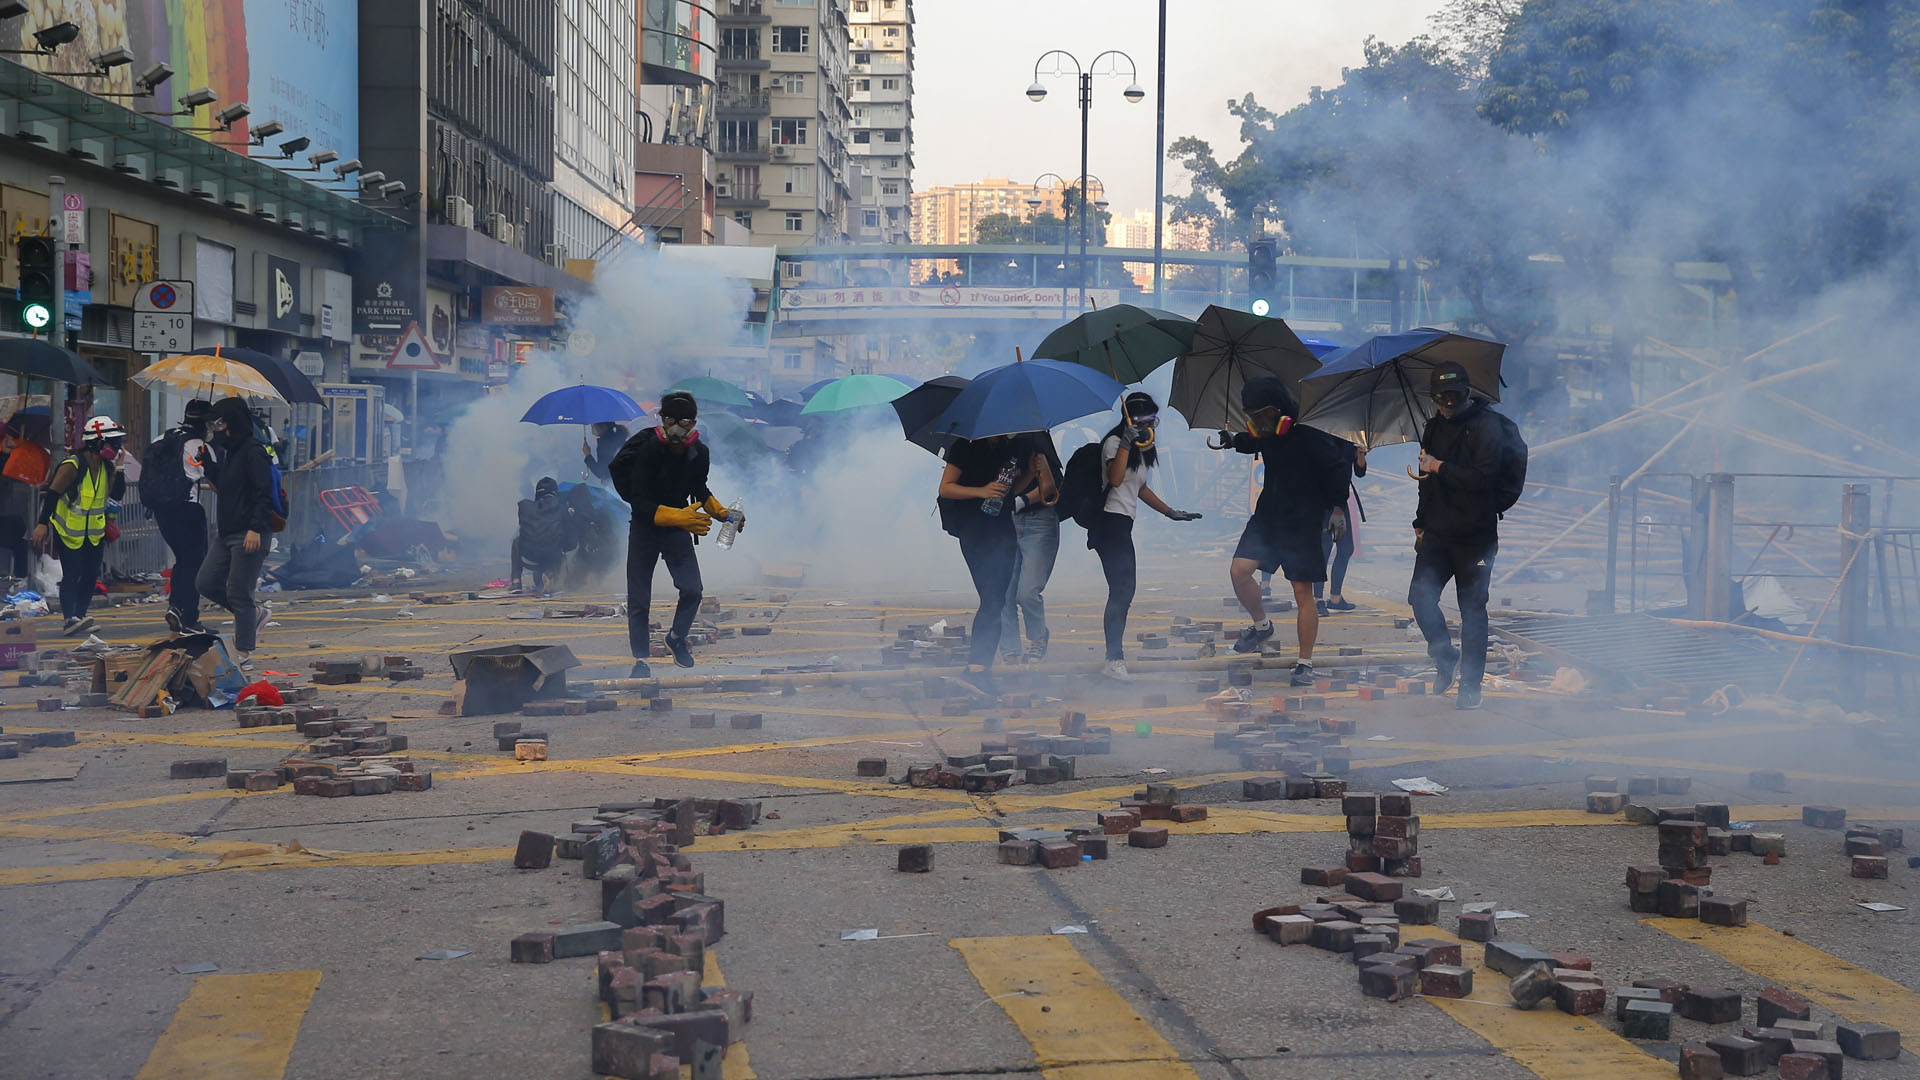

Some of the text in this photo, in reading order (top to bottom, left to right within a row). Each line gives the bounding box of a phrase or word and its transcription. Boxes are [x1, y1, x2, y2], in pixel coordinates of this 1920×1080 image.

[970, 293, 979, 302] If
[982, 293, 1000, 303] You
[1003, 293, 1032, 304] Drink,
[1035, 293, 1061, 302] Don't
[356, 307, 412, 316] PARK HOTEL
[140, 320, 157, 328] 上午
[168, 318, 183, 329] 10
[140, 341, 157, 349] 下午
[168, 338, 177, 349] 9
